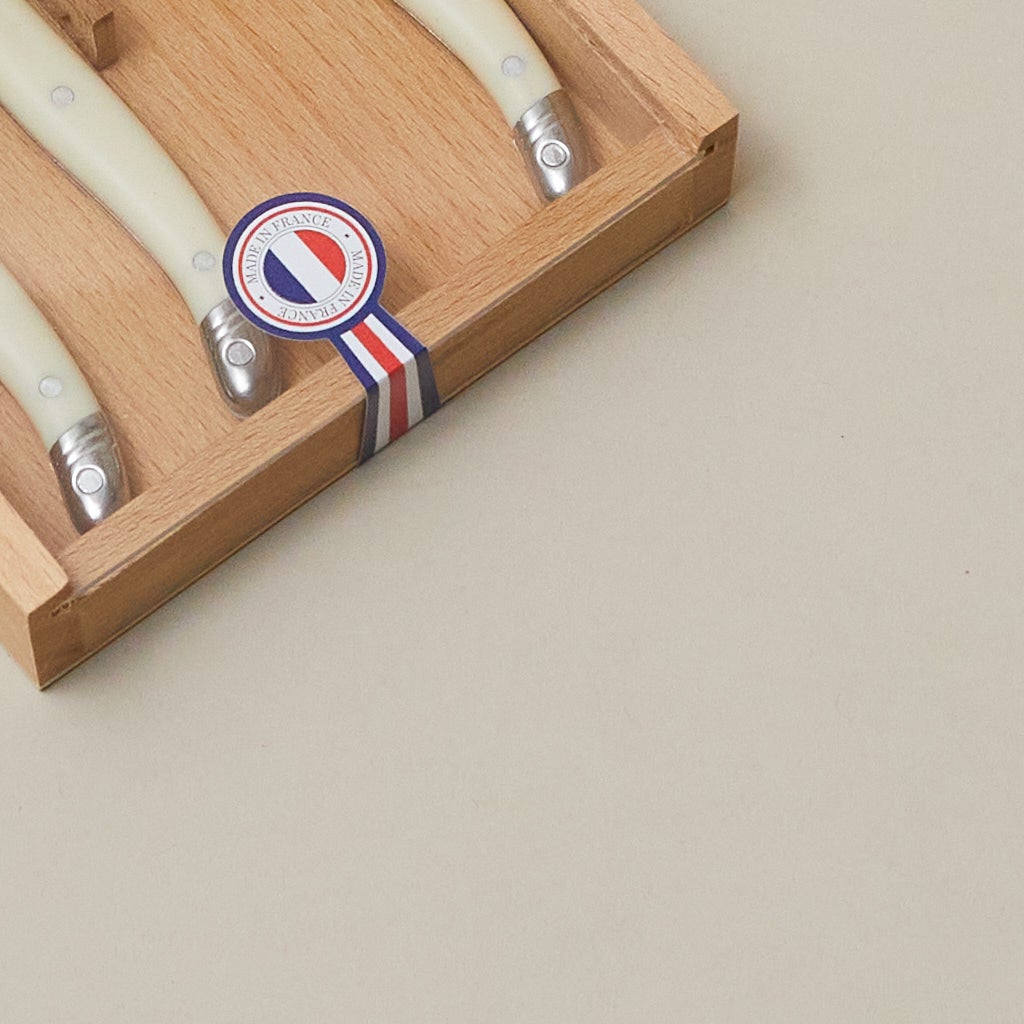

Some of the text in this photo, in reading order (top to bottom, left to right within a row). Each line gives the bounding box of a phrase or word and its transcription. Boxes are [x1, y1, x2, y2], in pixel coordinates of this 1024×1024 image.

[245, 213, 333, 285] MADE IN FRANCE
[277, 249, 364, 322] MADE IN FRANCE
